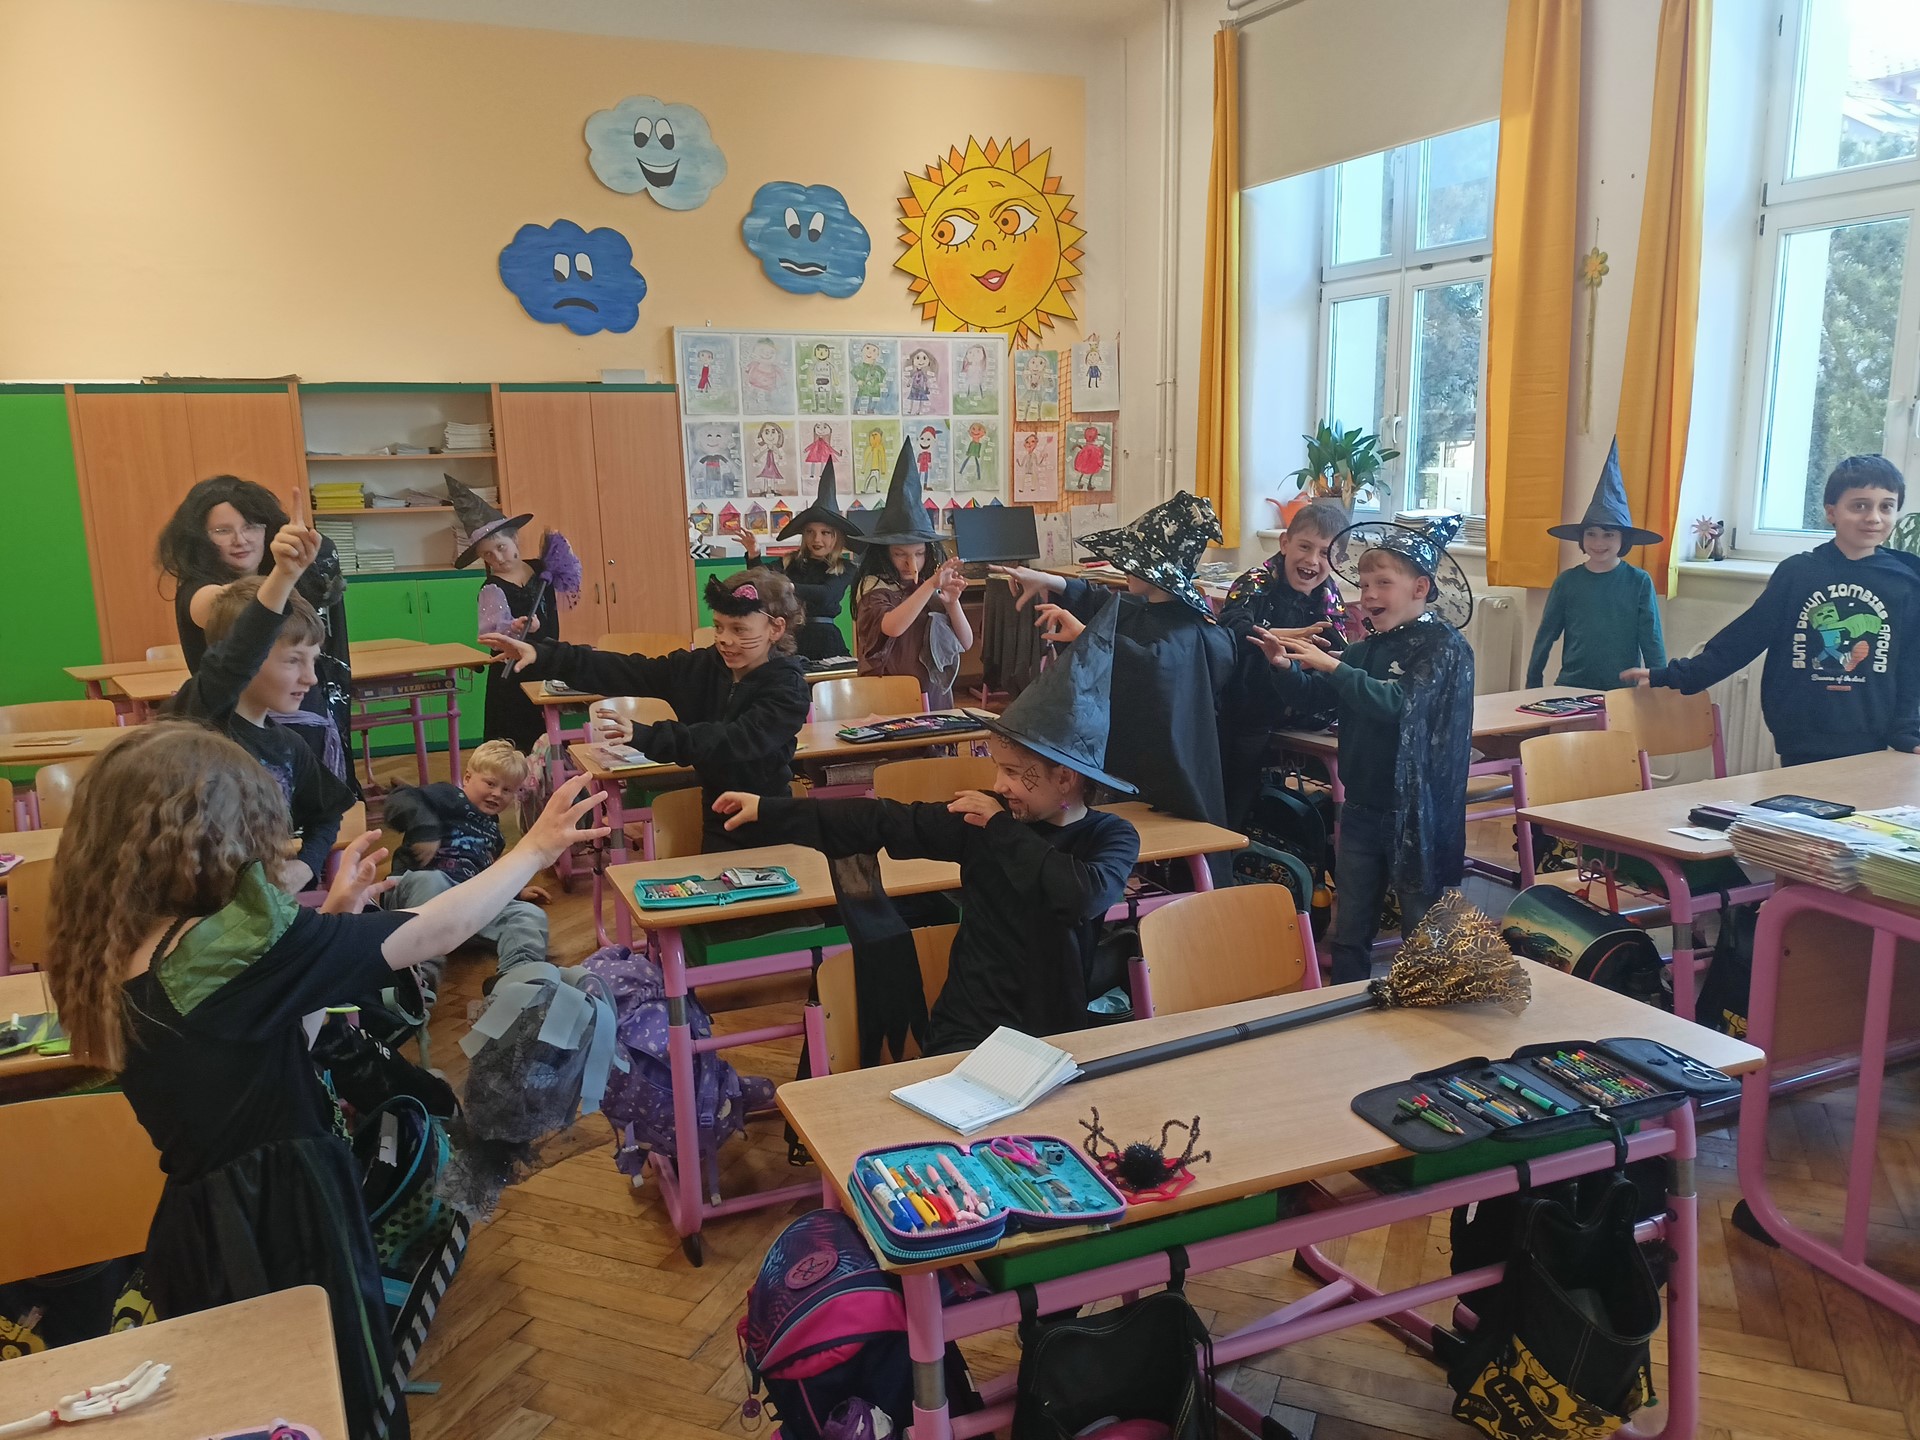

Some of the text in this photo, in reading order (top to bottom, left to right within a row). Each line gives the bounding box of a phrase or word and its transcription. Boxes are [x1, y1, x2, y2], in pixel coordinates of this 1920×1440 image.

[1827, 583, 1889, 620] ZOMBIES
[1872, 624, 1891, 674] AROUND
[1494, 1382, 1535, 1429] LIKE
